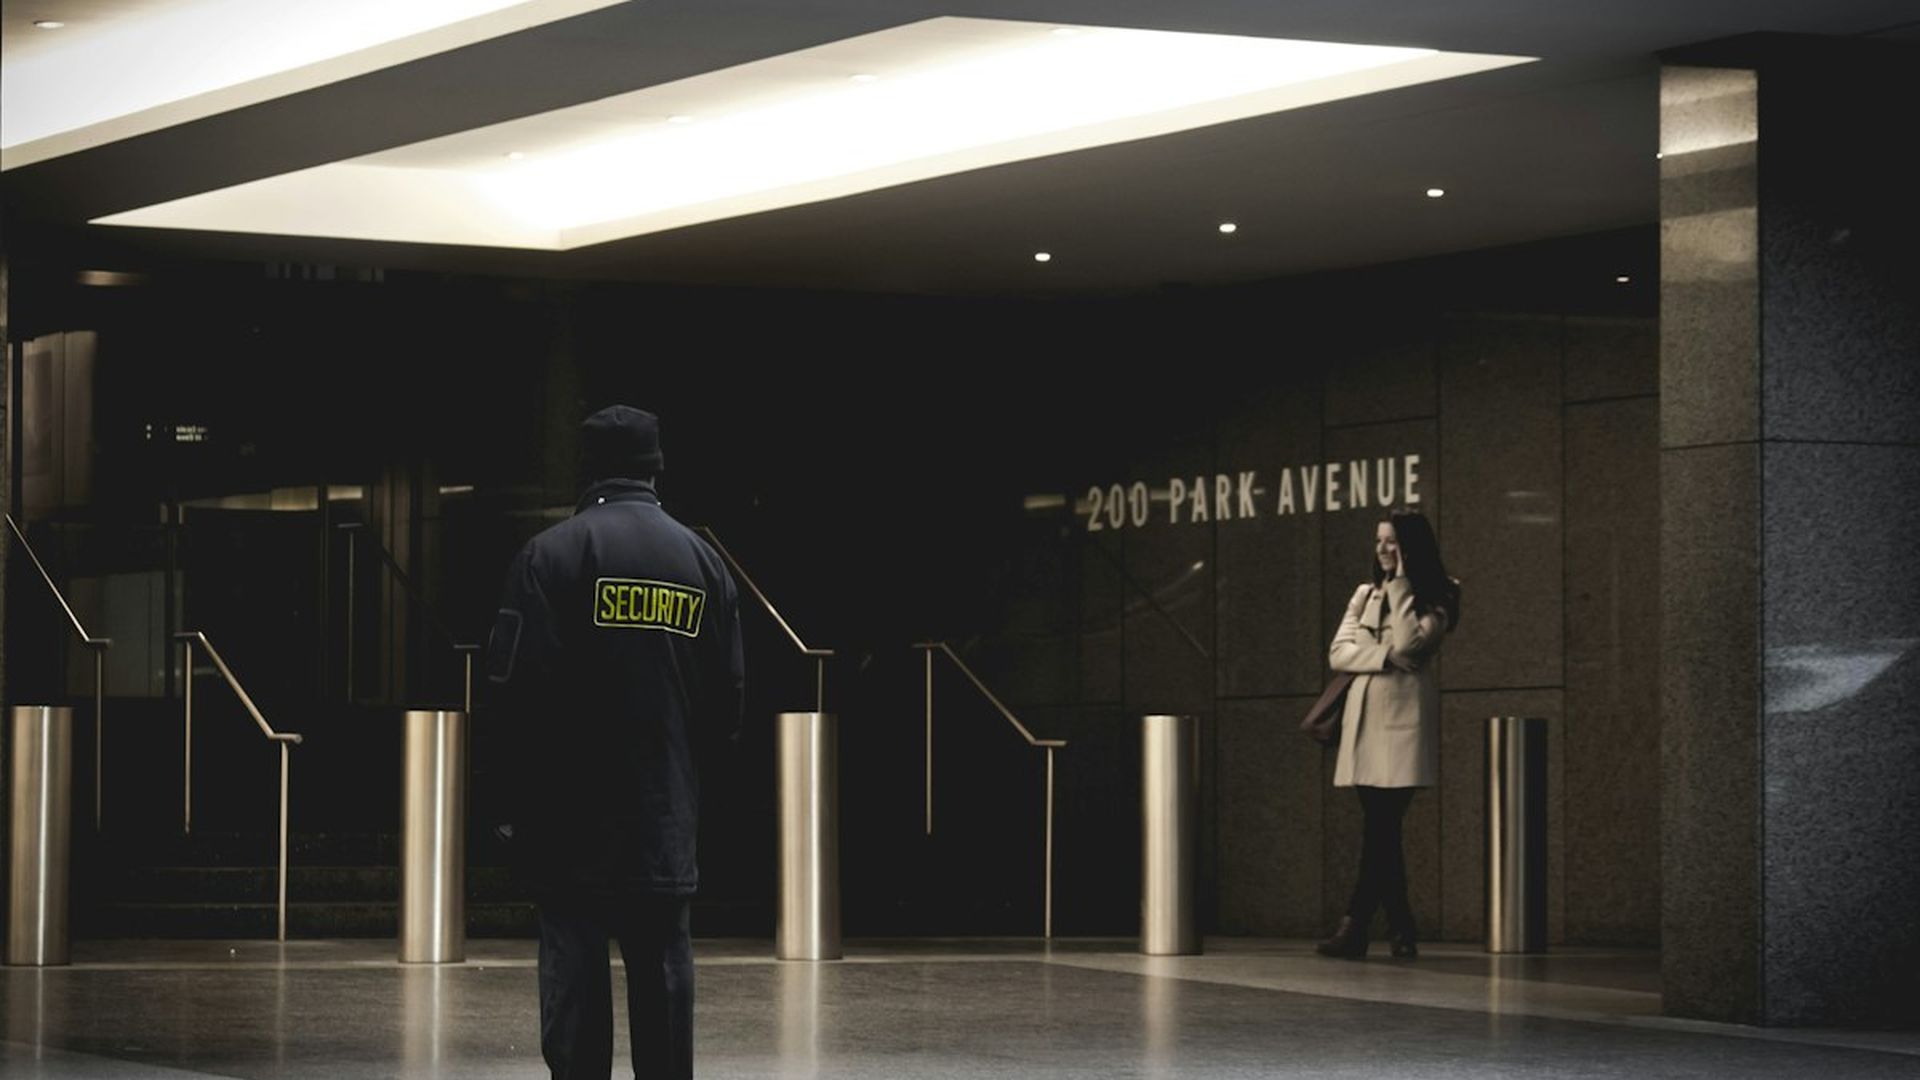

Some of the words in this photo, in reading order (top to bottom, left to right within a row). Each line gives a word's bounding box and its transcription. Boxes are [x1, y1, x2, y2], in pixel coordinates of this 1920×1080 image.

[1087, 481, 1148, 531] 200
[1169, 471, 1256, 524] PARK
[1277, 454, 1421, 515] AVENUE
[601, 585, 701, 629] SECURITY
